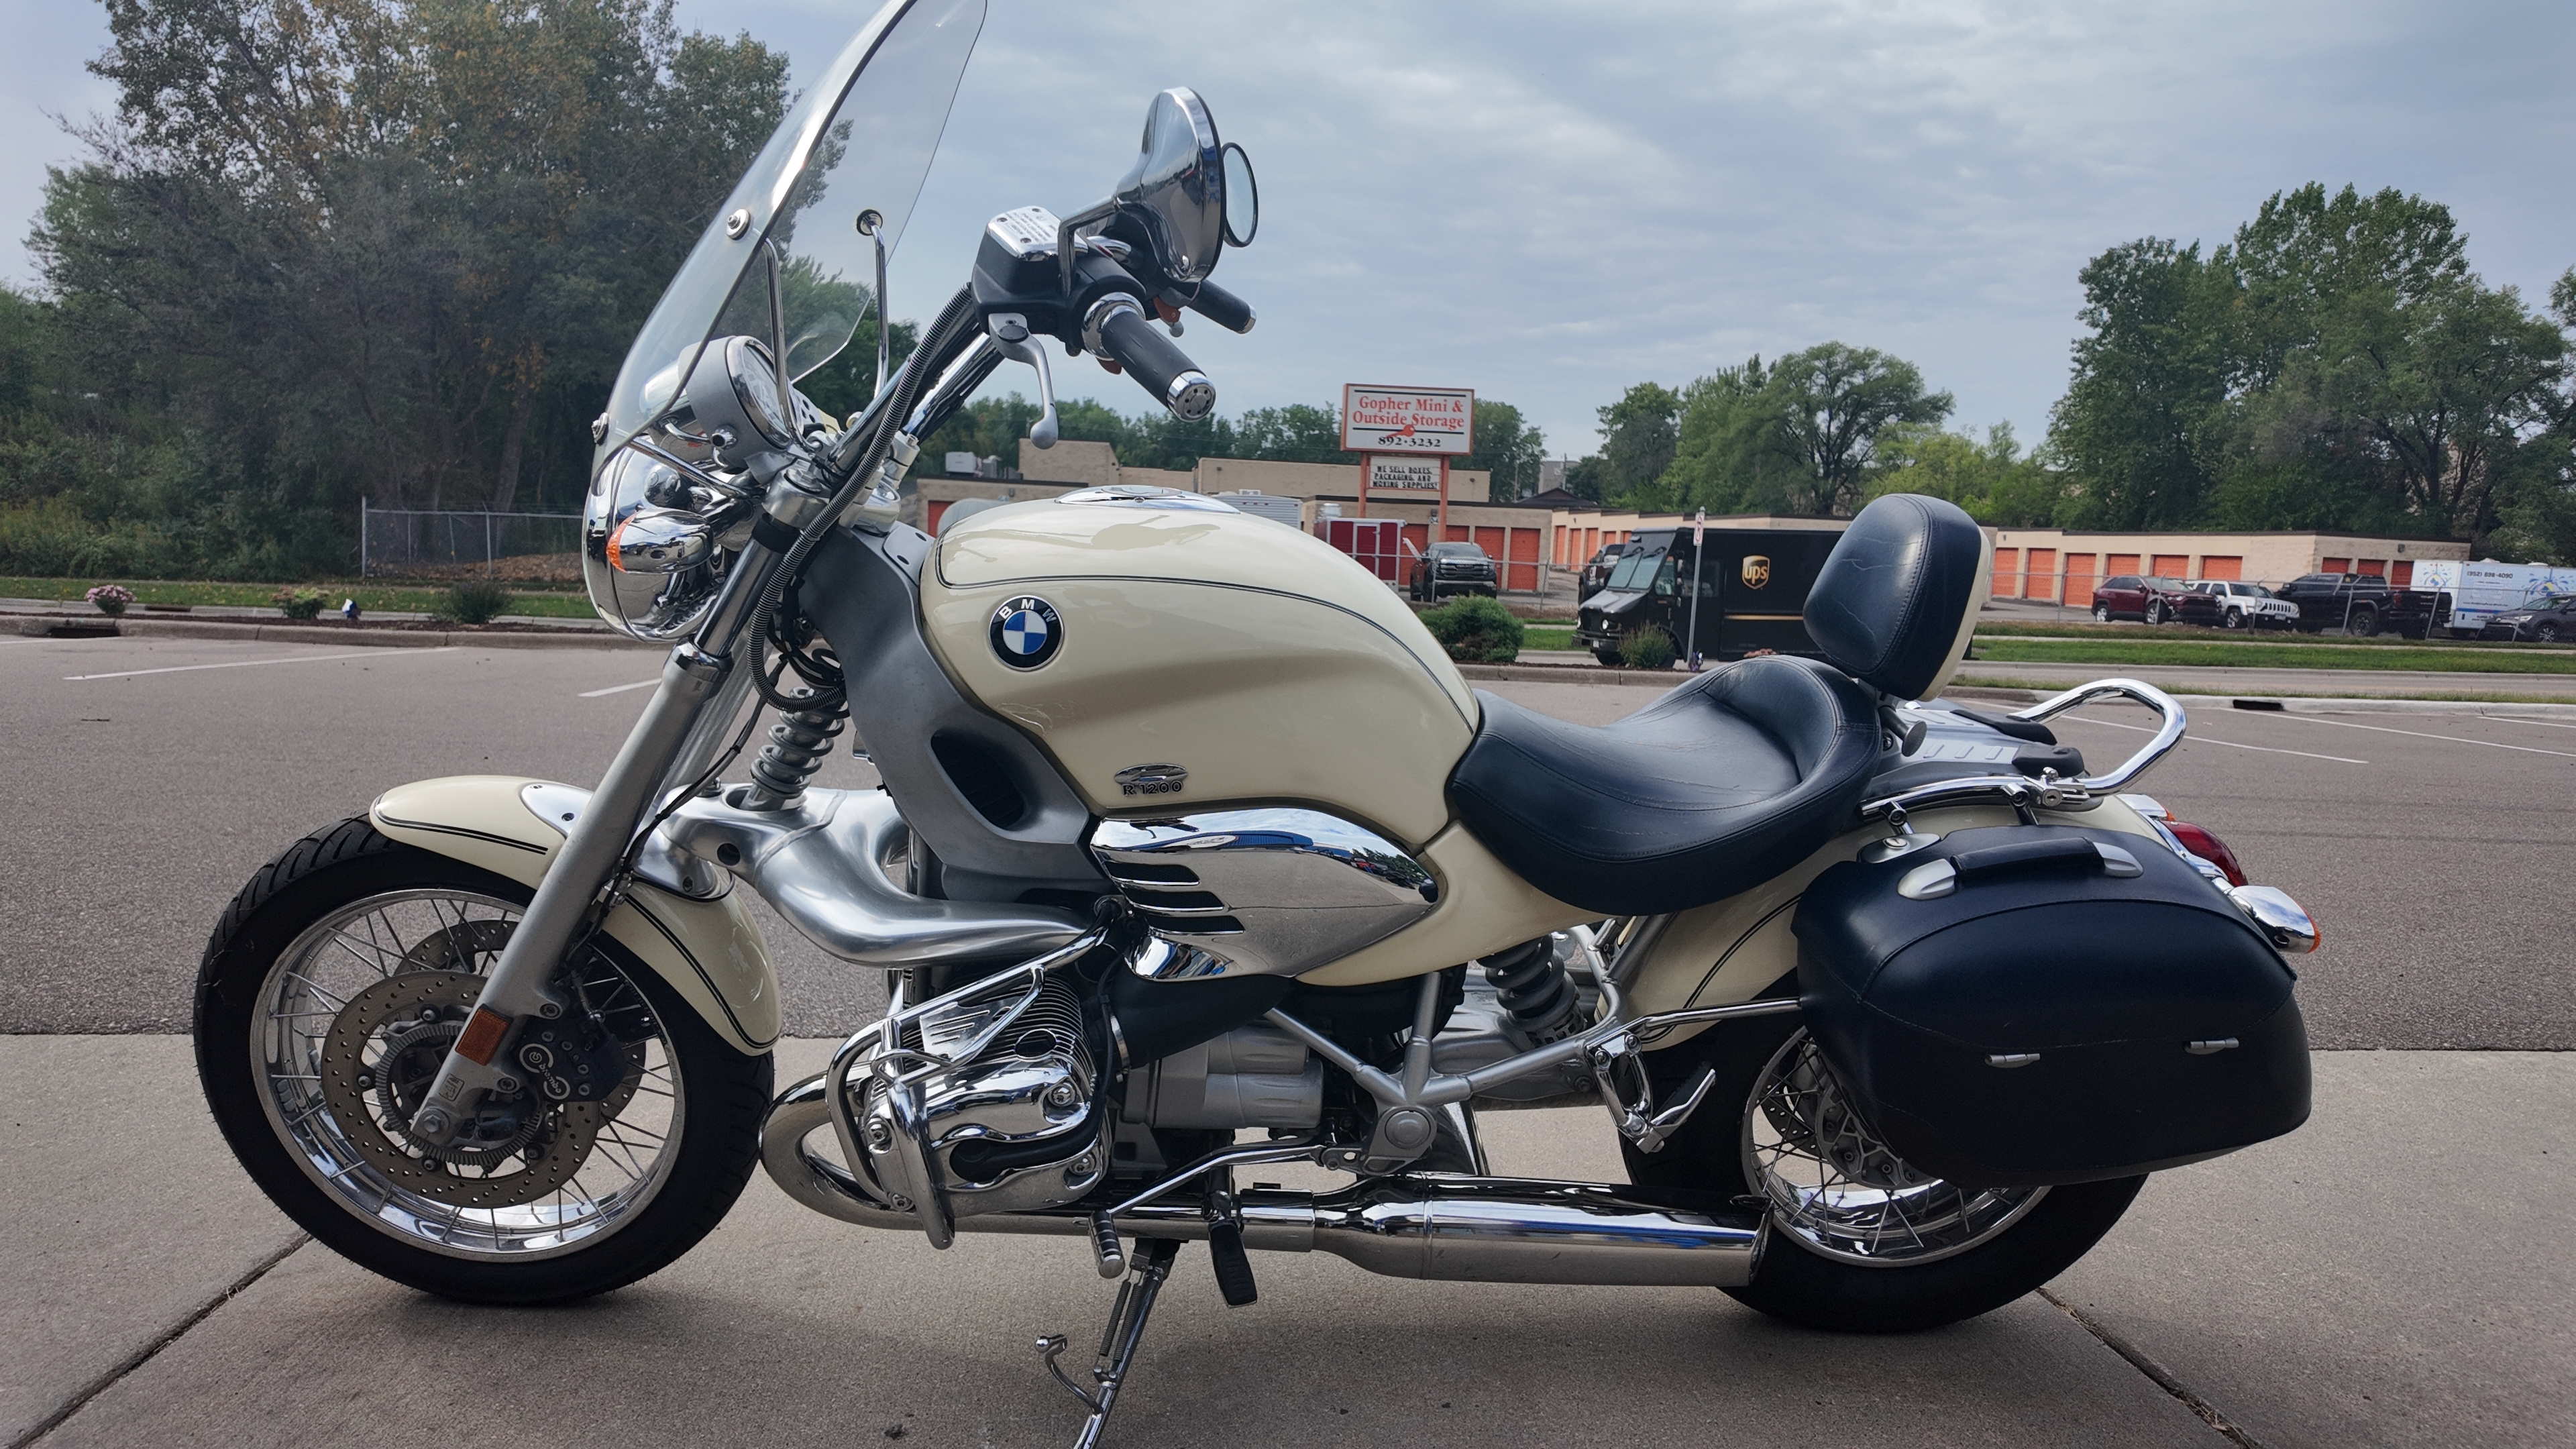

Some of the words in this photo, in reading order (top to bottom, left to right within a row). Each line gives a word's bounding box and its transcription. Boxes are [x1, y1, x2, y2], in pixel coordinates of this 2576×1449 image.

[1359, 396, 1411, 413] Gopher
[1415, 398, 1448, 412] Mini
[1452, 400, 1463, 413] &
[1352, 411, 1407, 425] Outside
[1411, 413, 1464, 430] Storage
[1744, 566, 1767, 584] ups
[999, 598, 1057, 623] BMW
[1122, 784, 1135, 796] R
[1140, 780, 1183, 794] 1200
[539, 1063, 561, 1093] brembo
